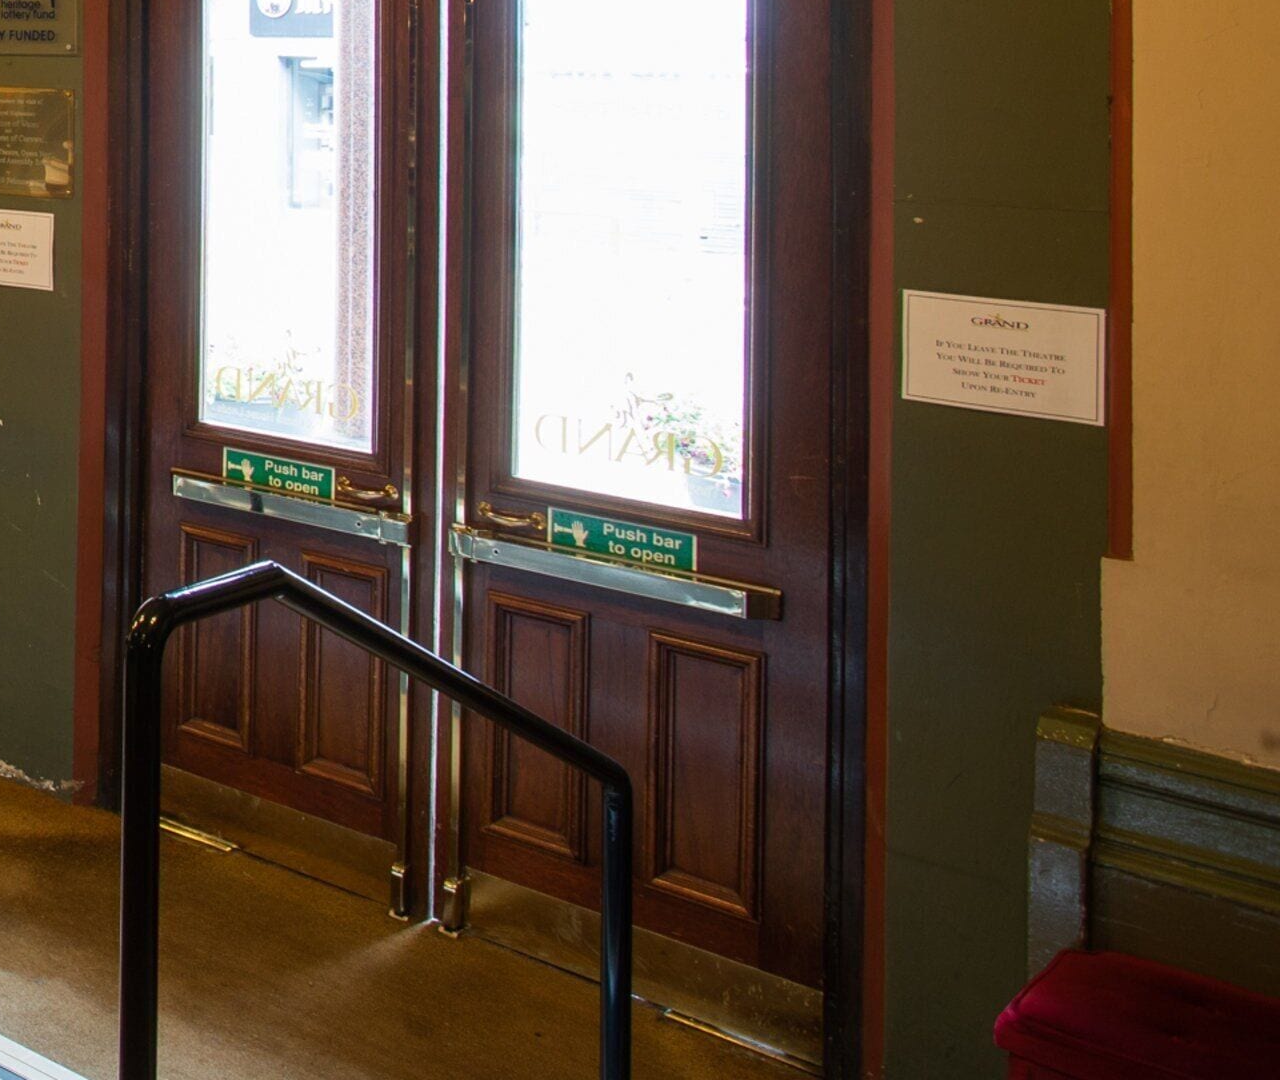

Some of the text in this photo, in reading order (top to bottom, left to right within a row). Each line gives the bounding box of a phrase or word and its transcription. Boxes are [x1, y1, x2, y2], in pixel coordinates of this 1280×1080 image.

[1, 0, 40, 11] heritage
[1, 10, 55, 20] lottery fund
[9, 30, 55, 41] FUNDED
[971, 316, 1029, 330] GRAND
[945, 340, 965, 350] YOU
[967, 343, 996, 354] LEAVE
[999, 347, 1019, 357] THE
[1021, 349, 1066, 362] THEATRE
[936, 352, 1066, 375] YOU WILL BE REQUIRED TO
[952, 368, 1047, 386] SHOW YOUR TICKET
[961, 381, 1037, 399] UPON RE-ENTRY
[264, 460, 325, 482] Push bar
[268, 475, 319, 495] to open
[603, 523, 682, 550] Push bar
[608, 541, 675, 565] to open
